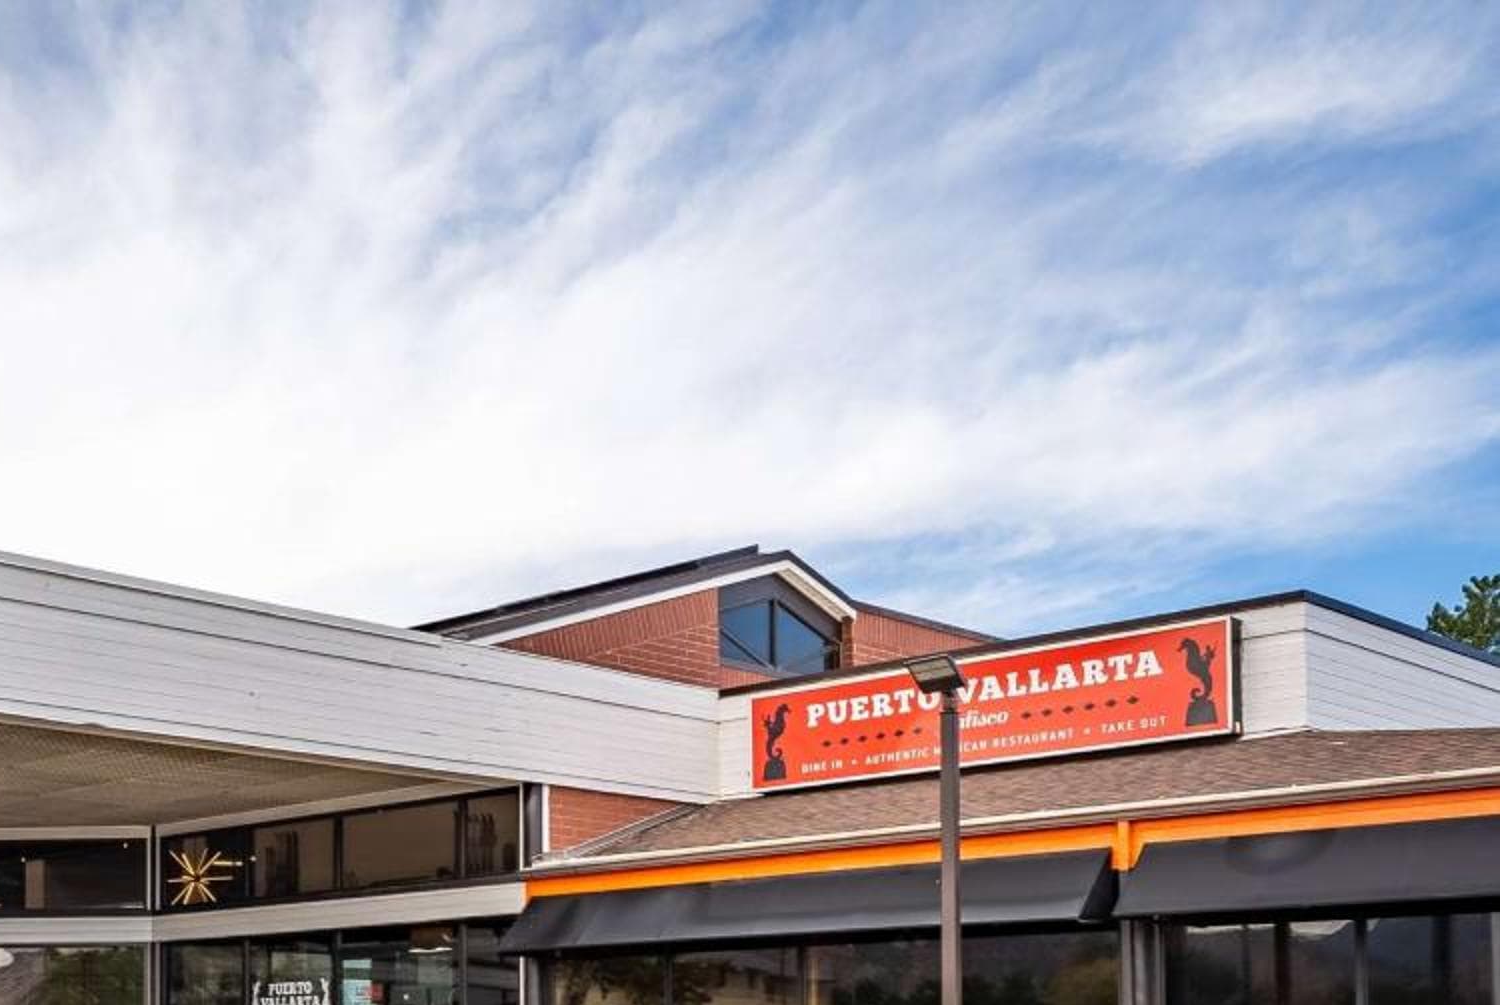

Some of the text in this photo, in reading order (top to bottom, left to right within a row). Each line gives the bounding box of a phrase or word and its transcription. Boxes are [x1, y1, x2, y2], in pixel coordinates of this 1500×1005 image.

[806, 650, 1163, 728] PUERTO VALLARTA
[801, 715, 1167, 774] DINE IN AUTHENTIC MICAN RESTAURANT TAKE OUT
[267, 981, 313, 996] PUERTO
